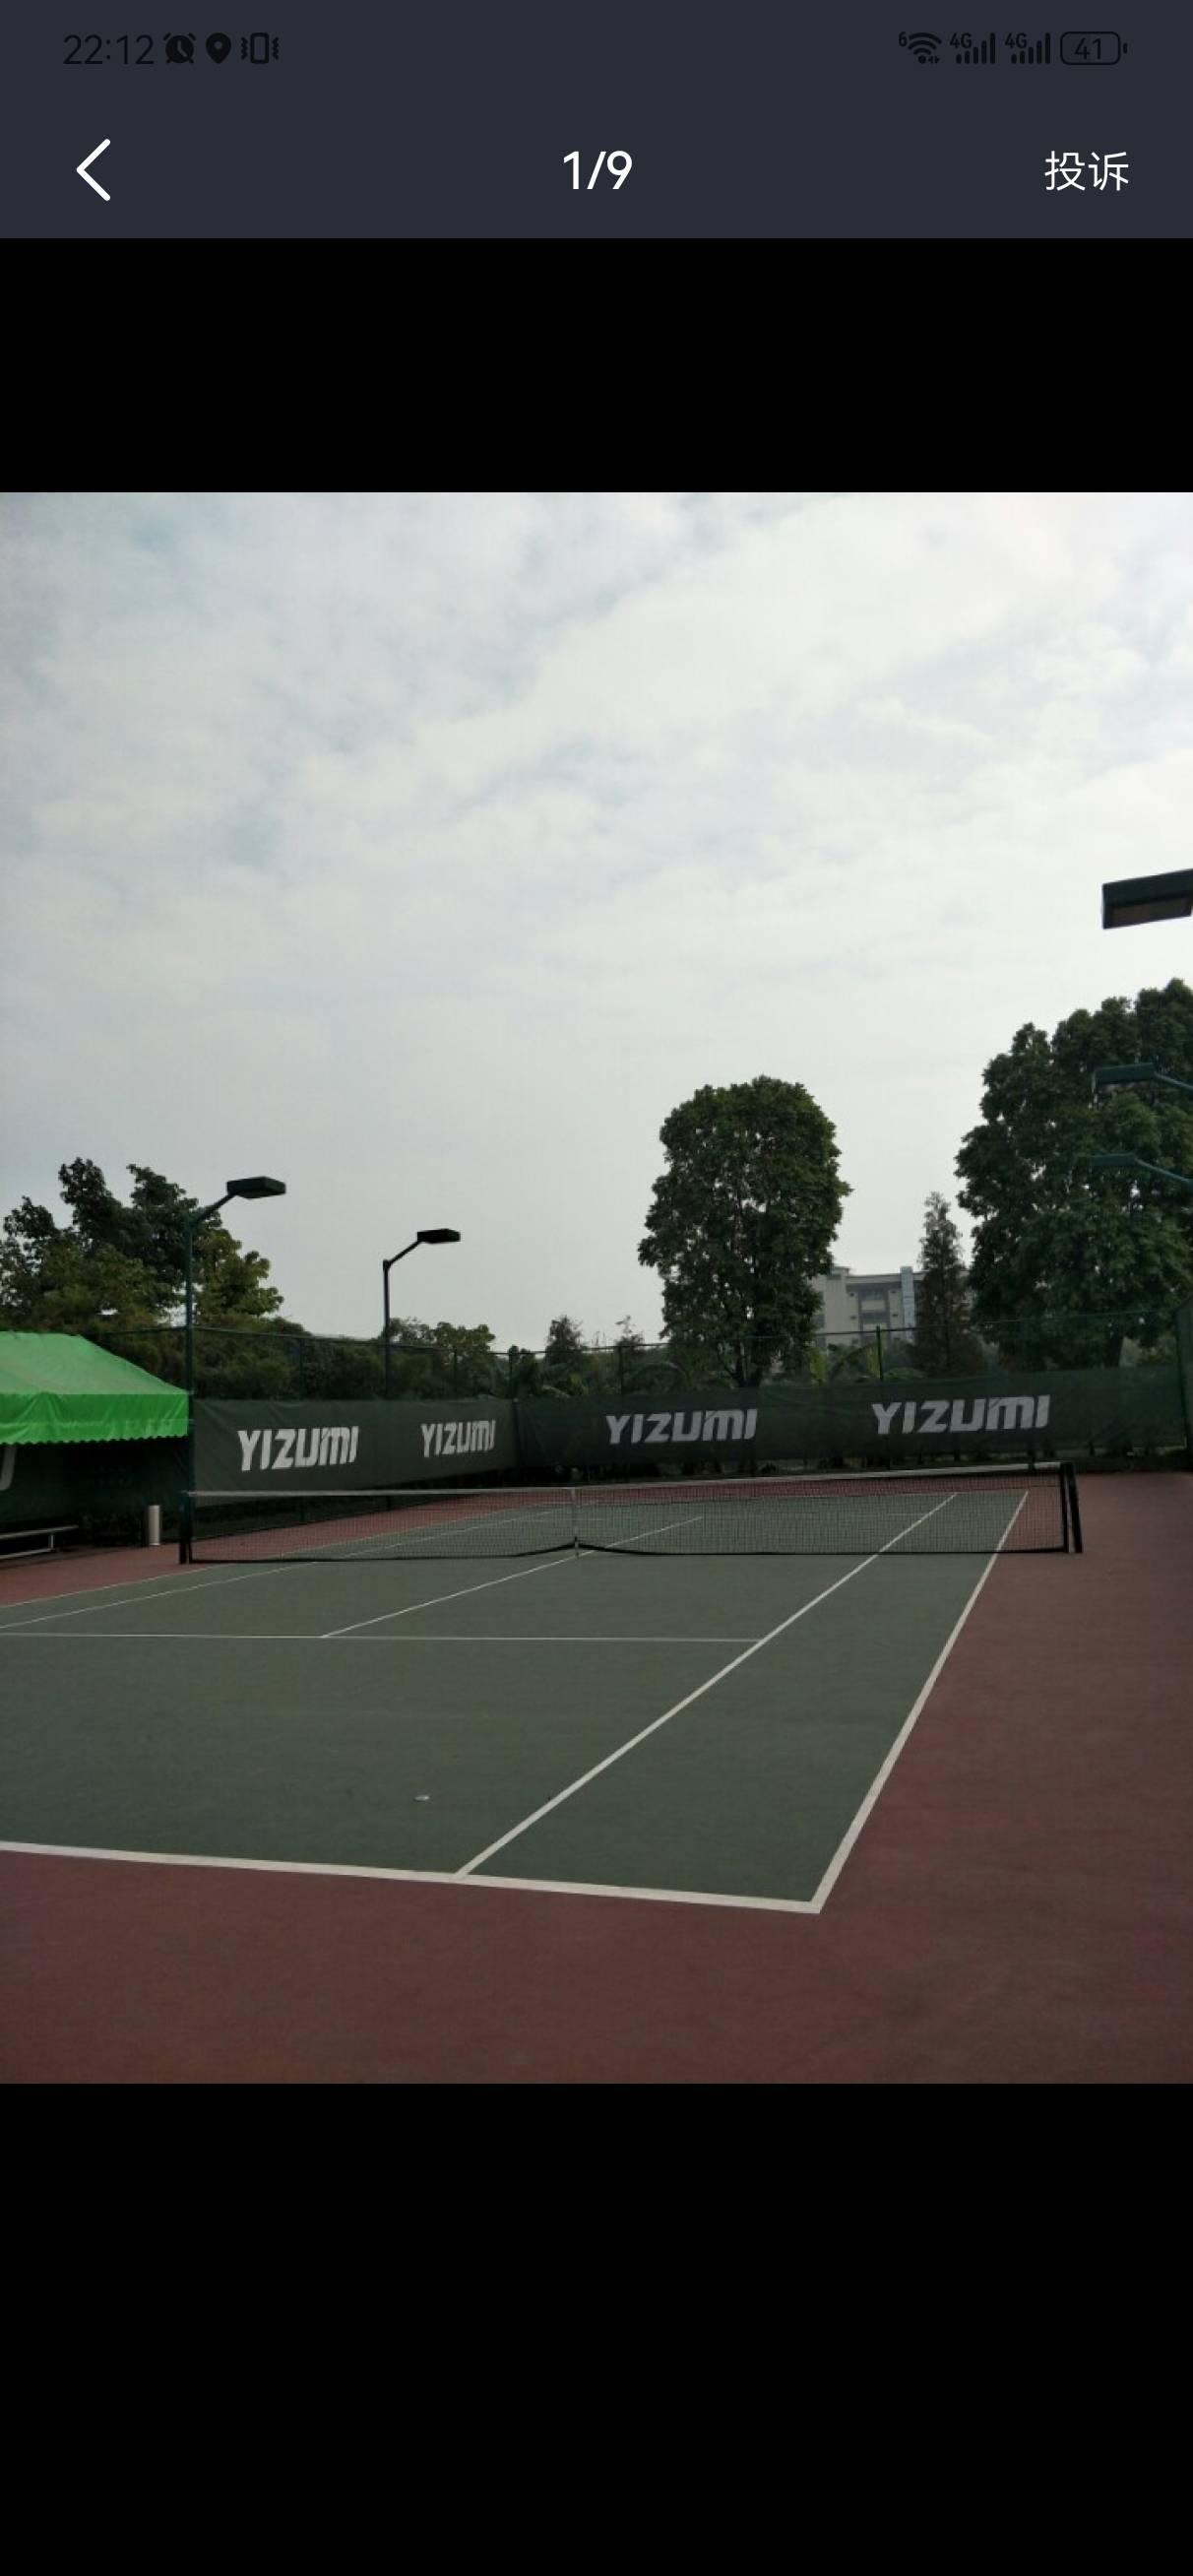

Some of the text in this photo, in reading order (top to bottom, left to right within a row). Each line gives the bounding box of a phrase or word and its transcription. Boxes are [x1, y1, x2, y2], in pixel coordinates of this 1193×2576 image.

[605, 1409, 758, 1446] YIZUMI
[871, 1394, 1051, 1436] YIZUMI
[237, 1426, 359, 1472] YIZUMI
[420, 1419, 496, 1458] YIZUMI
